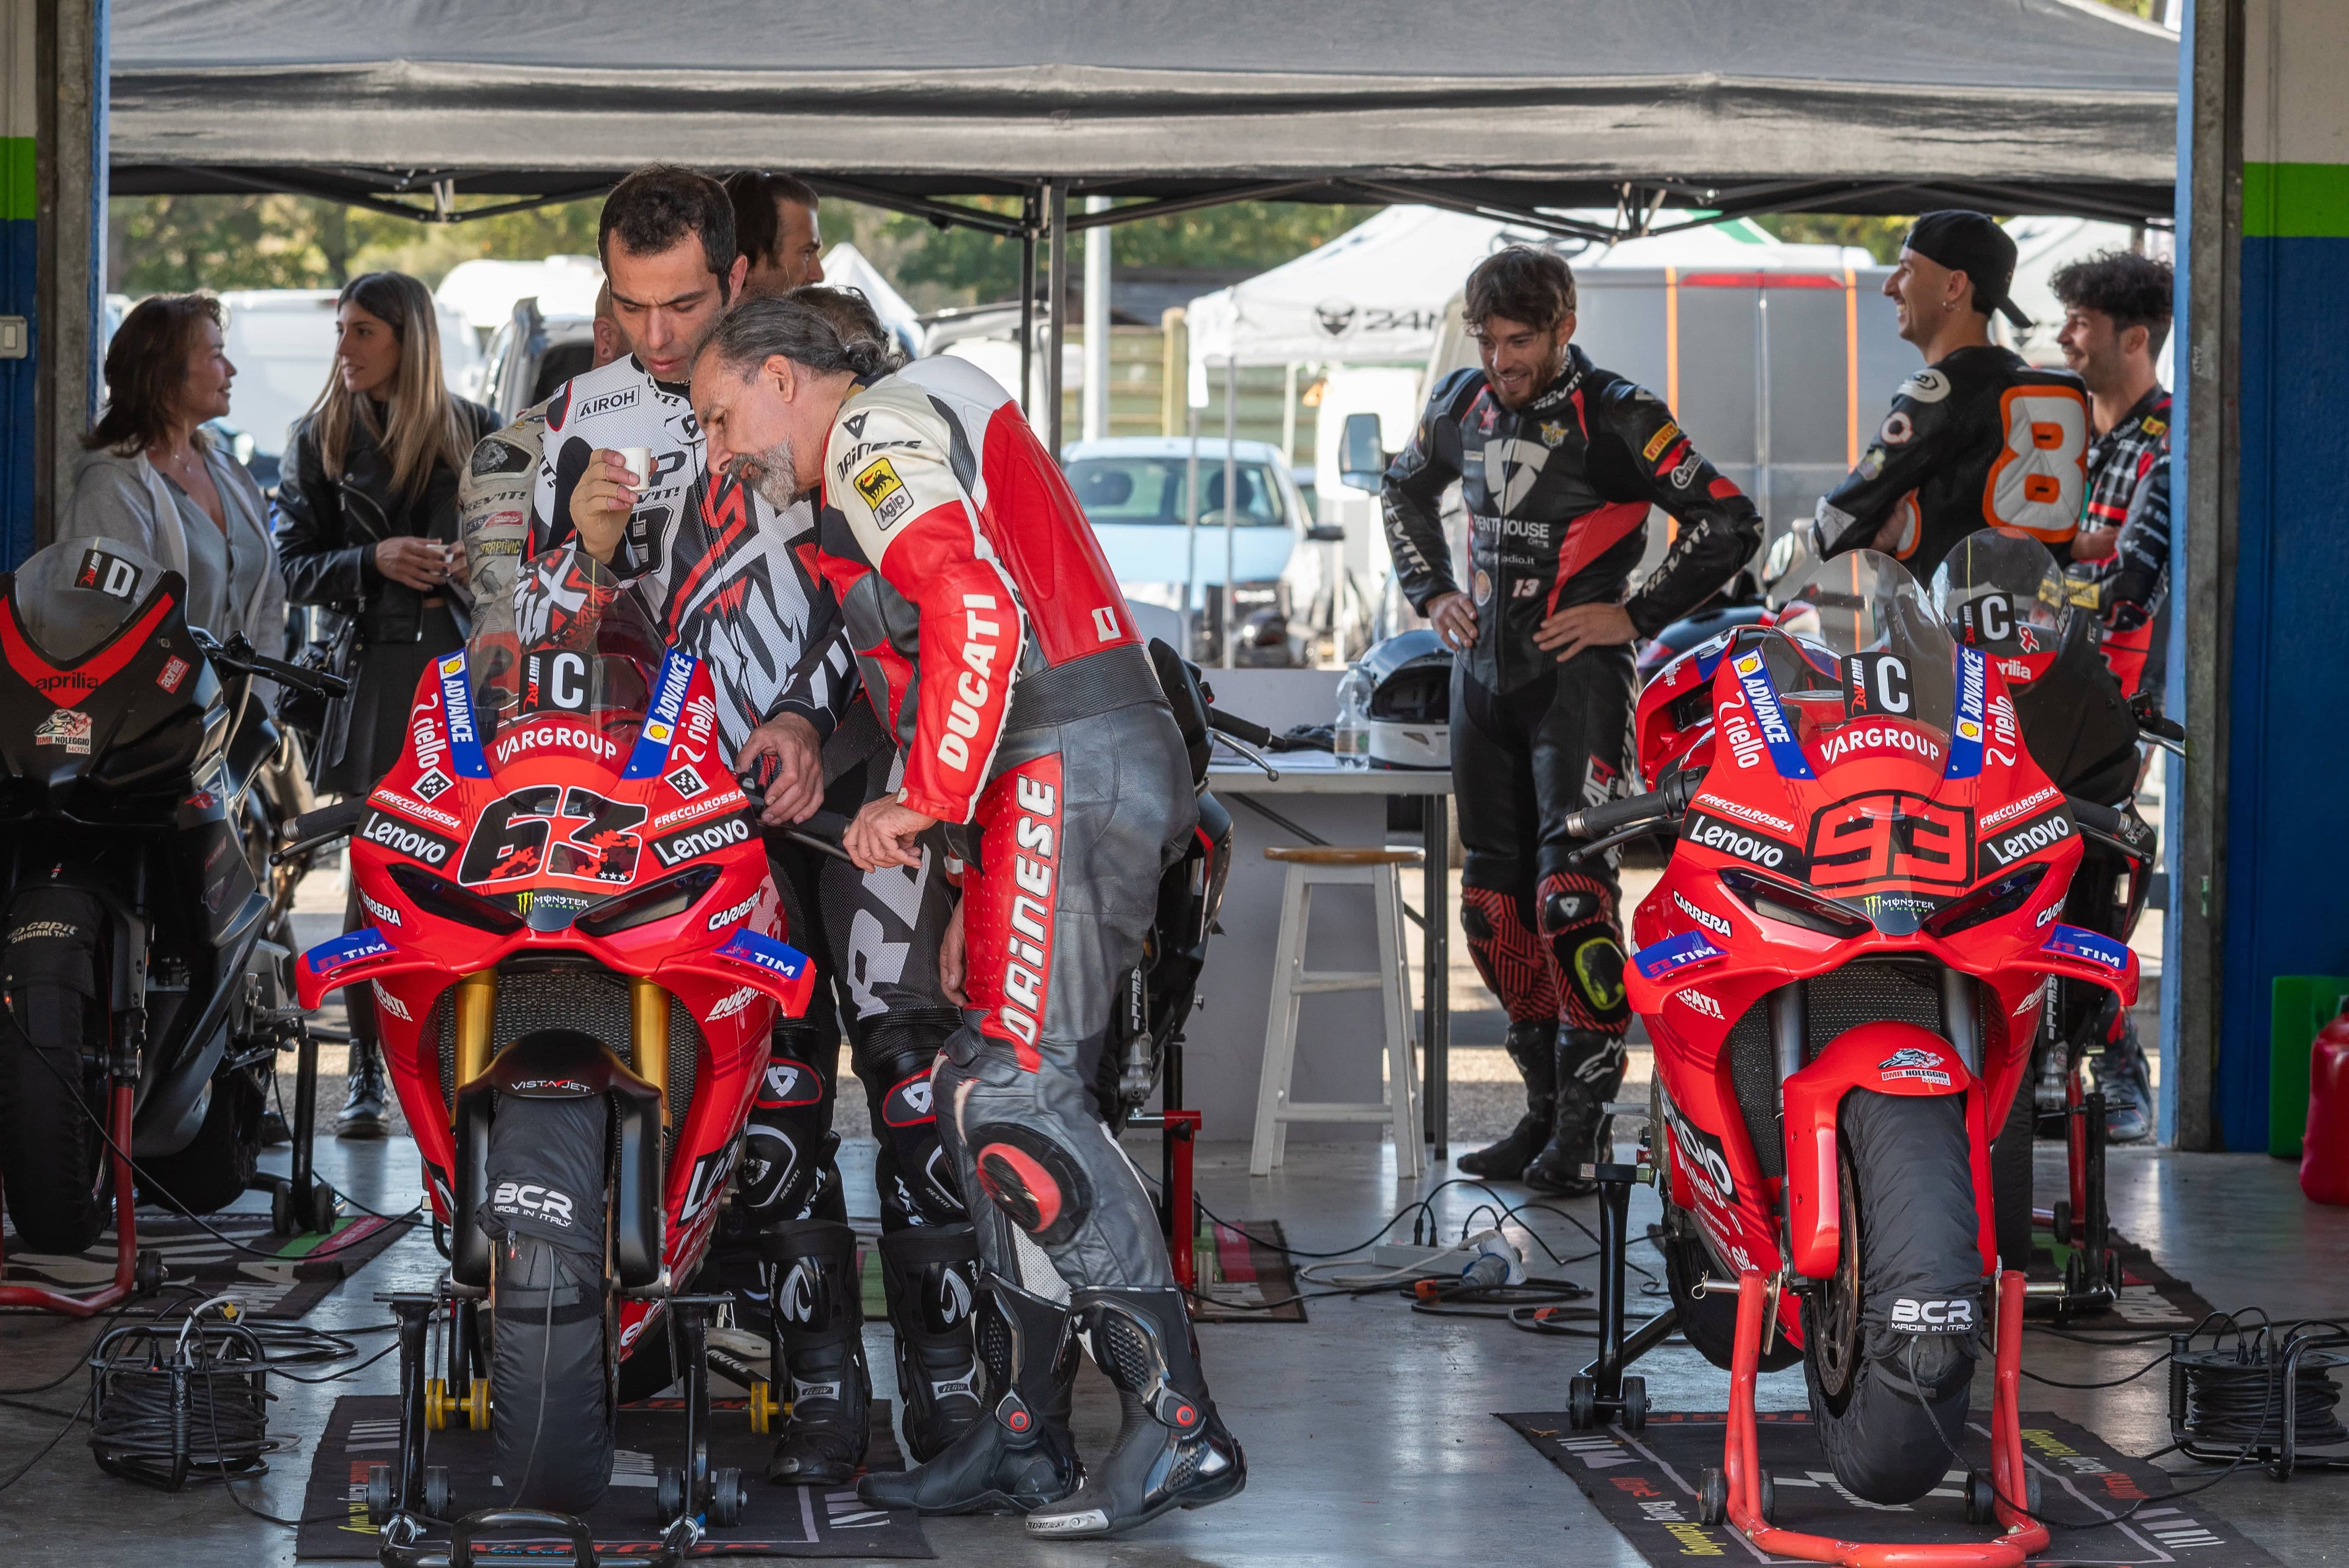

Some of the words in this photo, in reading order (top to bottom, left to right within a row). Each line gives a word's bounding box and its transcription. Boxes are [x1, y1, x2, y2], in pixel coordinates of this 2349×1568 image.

[579, 390, 635, 417] AIROH
[1983, 384, 2089, 543] 8
[464, 491, 527, 514] REV'IT!
[879, 494, 905, 523] Agip
[103, 557, 135, 597] D
[1512, 579, 1540, 597] 13
[1981, 595, 2009, 640] C
[35, 672, 98, 692] aprilia
[161, 660, 183, 687] aprilia
[552, 653, 585, 709] C
[661, 653, 693, 723] ADVANCE
[937, 593, 997, 773] DUCATI
[1877, 656, 1909, 713] C
[1962, 647, 1983, 720] ADVANCE
[1997, 659, 2031, 679] rilia
[443, 679, 473, 743] ADVANCE
[681, 695, 716, 745] riello
[1743, 679, 1791, 744] ADVANCE
[1986, 695, 2016, 747] riello
[37, 736, 53, 745] BMR
[54, 736, 90, 746] NOLEGGIO
[413, 717, 447, 769] riello
[496, 727, 617, 764] VARGROUP
[1723, 716, 1765, 769] riello
[1820, 728, 1940, 764] VARGROUP
[375, 790, 461, 829] FRECCIAROSSA
[654, 789, 746, 828] FRECCIAROSSA
[1697, 793, 1795, 833] FRECCIAROSSA
[1980, 786, 2058, 829] FRECCIAROSSA
[363, 812, 446, 864] Lenovo
[457, 784, 648, 887] 63
[654, 818, 749, 866] Lenovo
[1690, 815, 1784, 868] Lenovo
[1805, 789, 1978, 889] 93
[1986, 815, 2069, 865] Lenovo
[533, 894, 589, 908] MONSTER
[708, 889, 761, 931] CARRERA
[1000, 773, 1056, 1048] DAINESE
[1673, 890, 1732, 938] CARRERA
[1882, 898, 1935, 911] MONSTER
[12, 929, 52, 944] ORIGINAL
[27, 921, 78, 935] capit
[343, 943, 387, 959] TIM
[754, 952, 796, 977] TIM
[1672, 945, 1717, 964] TIM
[2079, 946, 2120, 968] TIM
[1132, 966, 1141, 1031] RELLI
[1680, 986, 1721, 1015] CATI
[2047, 974, 2058, 1040] RELLI
[1883, 1071, 1904, 1081] BMR
[1906, 1069, 1948, 1079] NOLEGGIO
[494, 1182, 573, 1221] BCR
[494, 1205, 519, 1214] MADE
[523, 1208, 535, 1217] IN
[539, 1213, 572, 1227] ITALY
[1891, 1298, 1975, 1324] BCR
[1891, 1322, 1923, 1331] MADE
[1931, 1322, 1943, 1331] IN
[1946, 1322, 1974, 1331] ITALY
[804, 1386, 829, 1395] FLOW
[941, 1383, 966, 1392] FLOW
[1661, 1522, 1727, 1556] Technology
